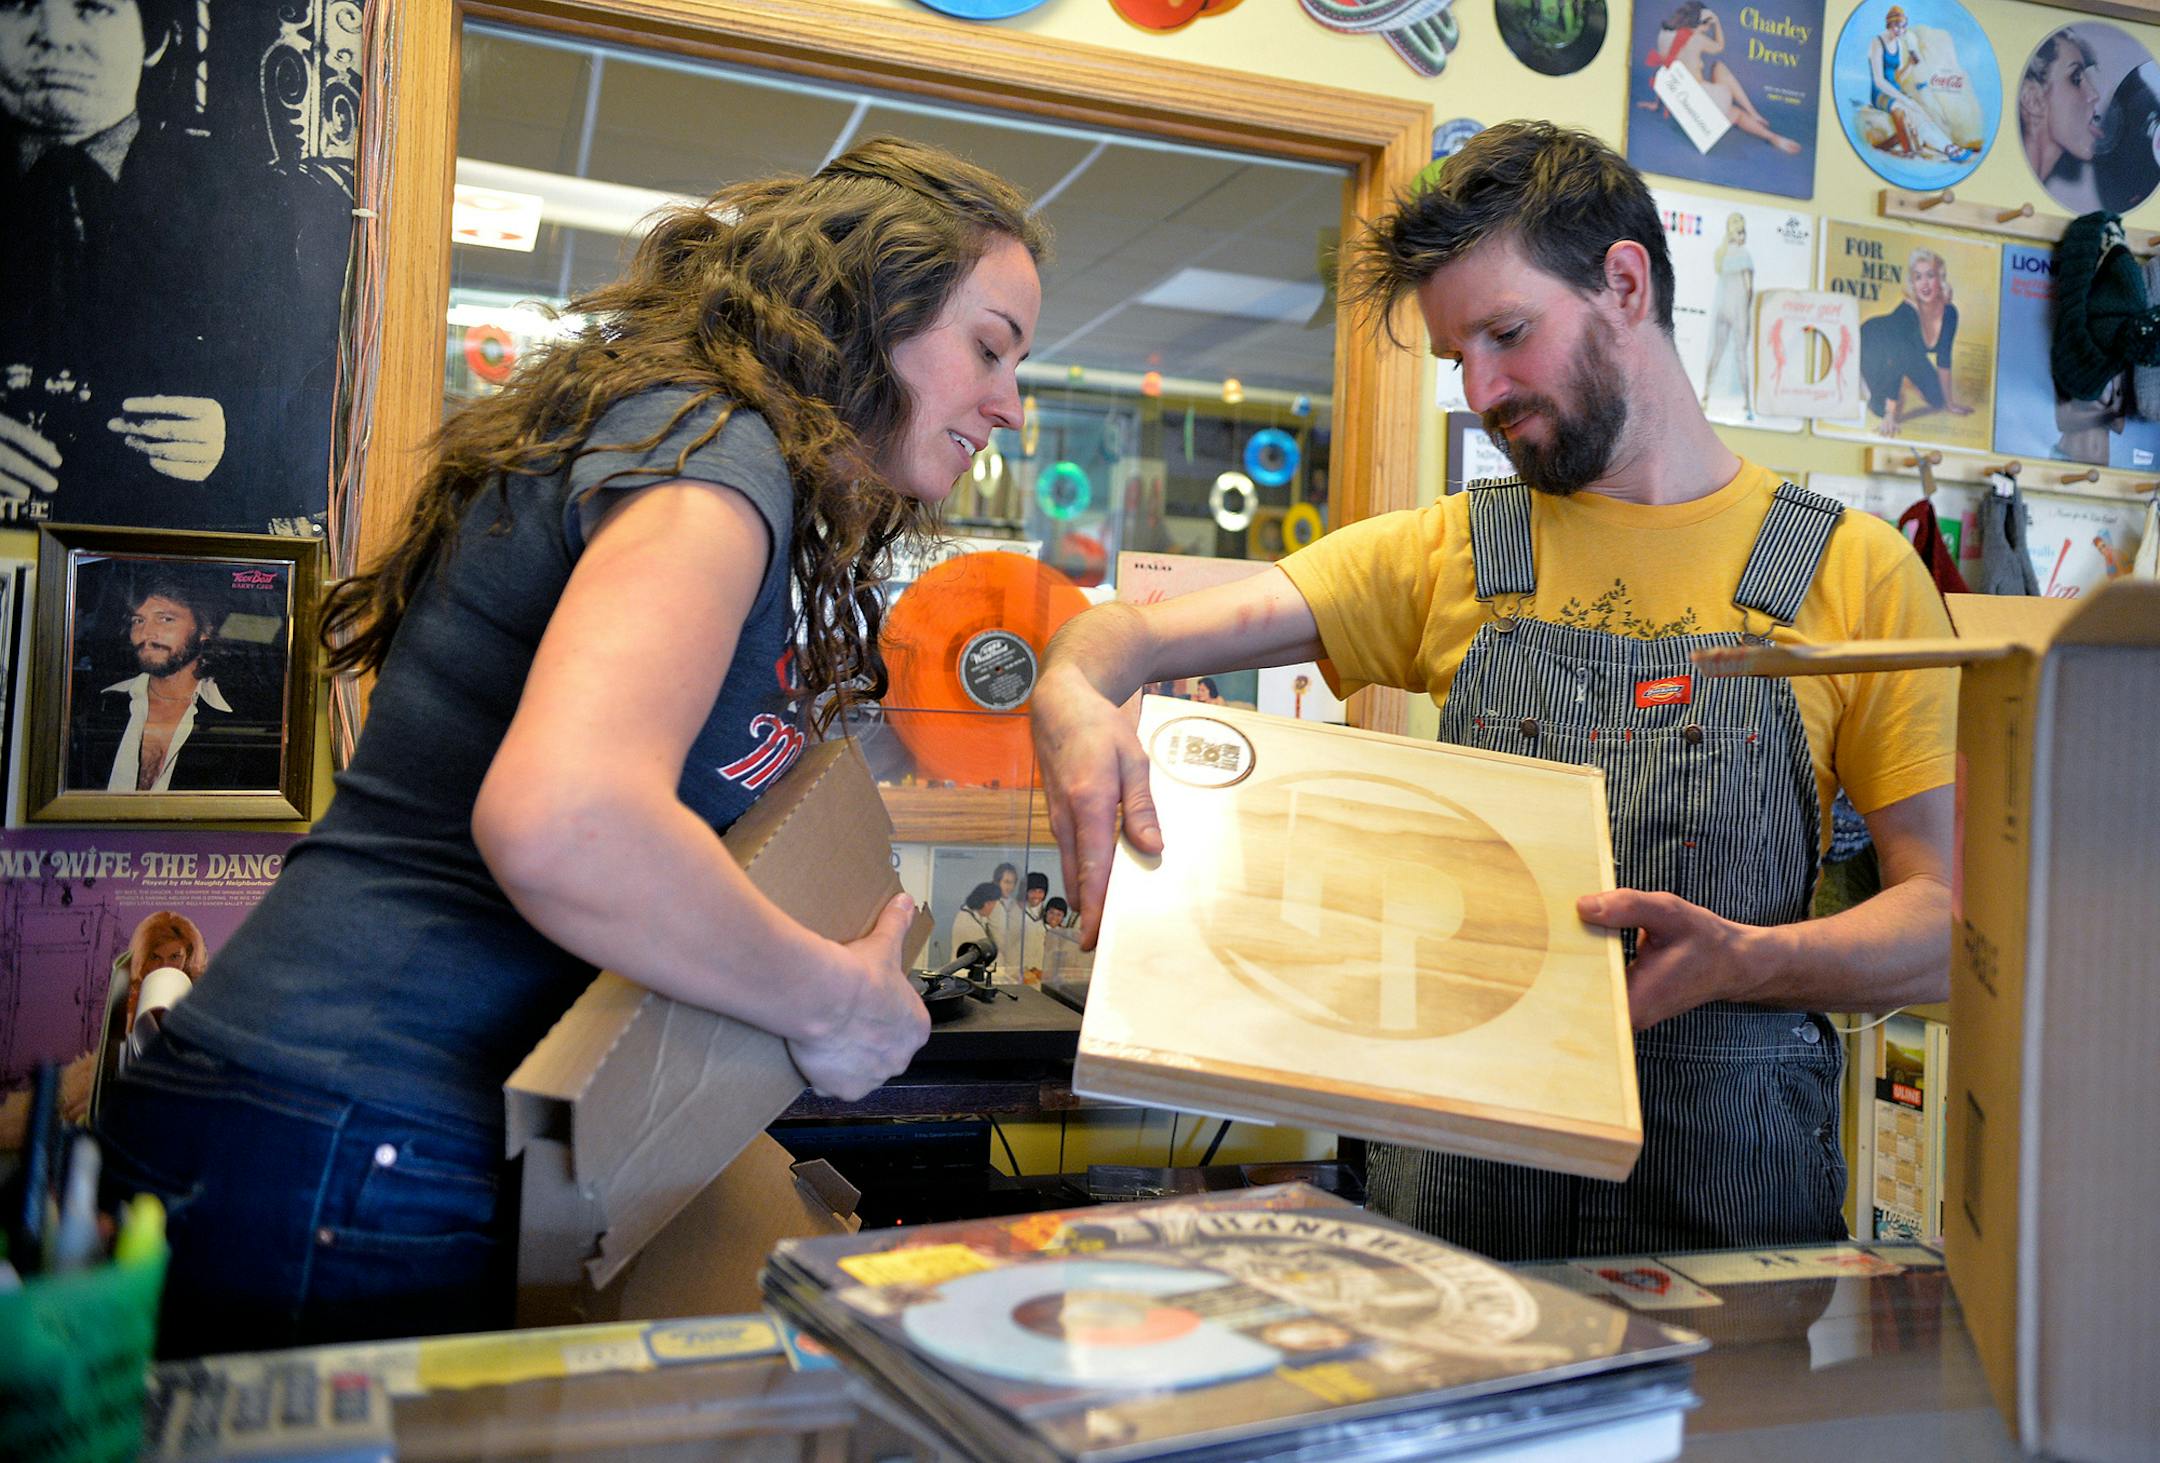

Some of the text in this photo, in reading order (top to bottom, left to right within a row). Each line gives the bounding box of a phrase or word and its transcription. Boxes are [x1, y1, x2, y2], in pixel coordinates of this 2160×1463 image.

[1740, 7, 1811, 43] Charley
[1748, 37, 1798, 67] Drew
[1845, 237, 1883, 260] FOR
[1862, 259, 1902, 284] MEN
[1831, 277, 1882, 301] ONLY
[1134, 562, 1173, 572] HALO
[0, 849, 50, 879] MY
[140, 851, 198, 879] THE
[205, 853, 286, 880] DANC
[168, 879, 179, 887] by
[194, 879, 224, 887] Naughty
